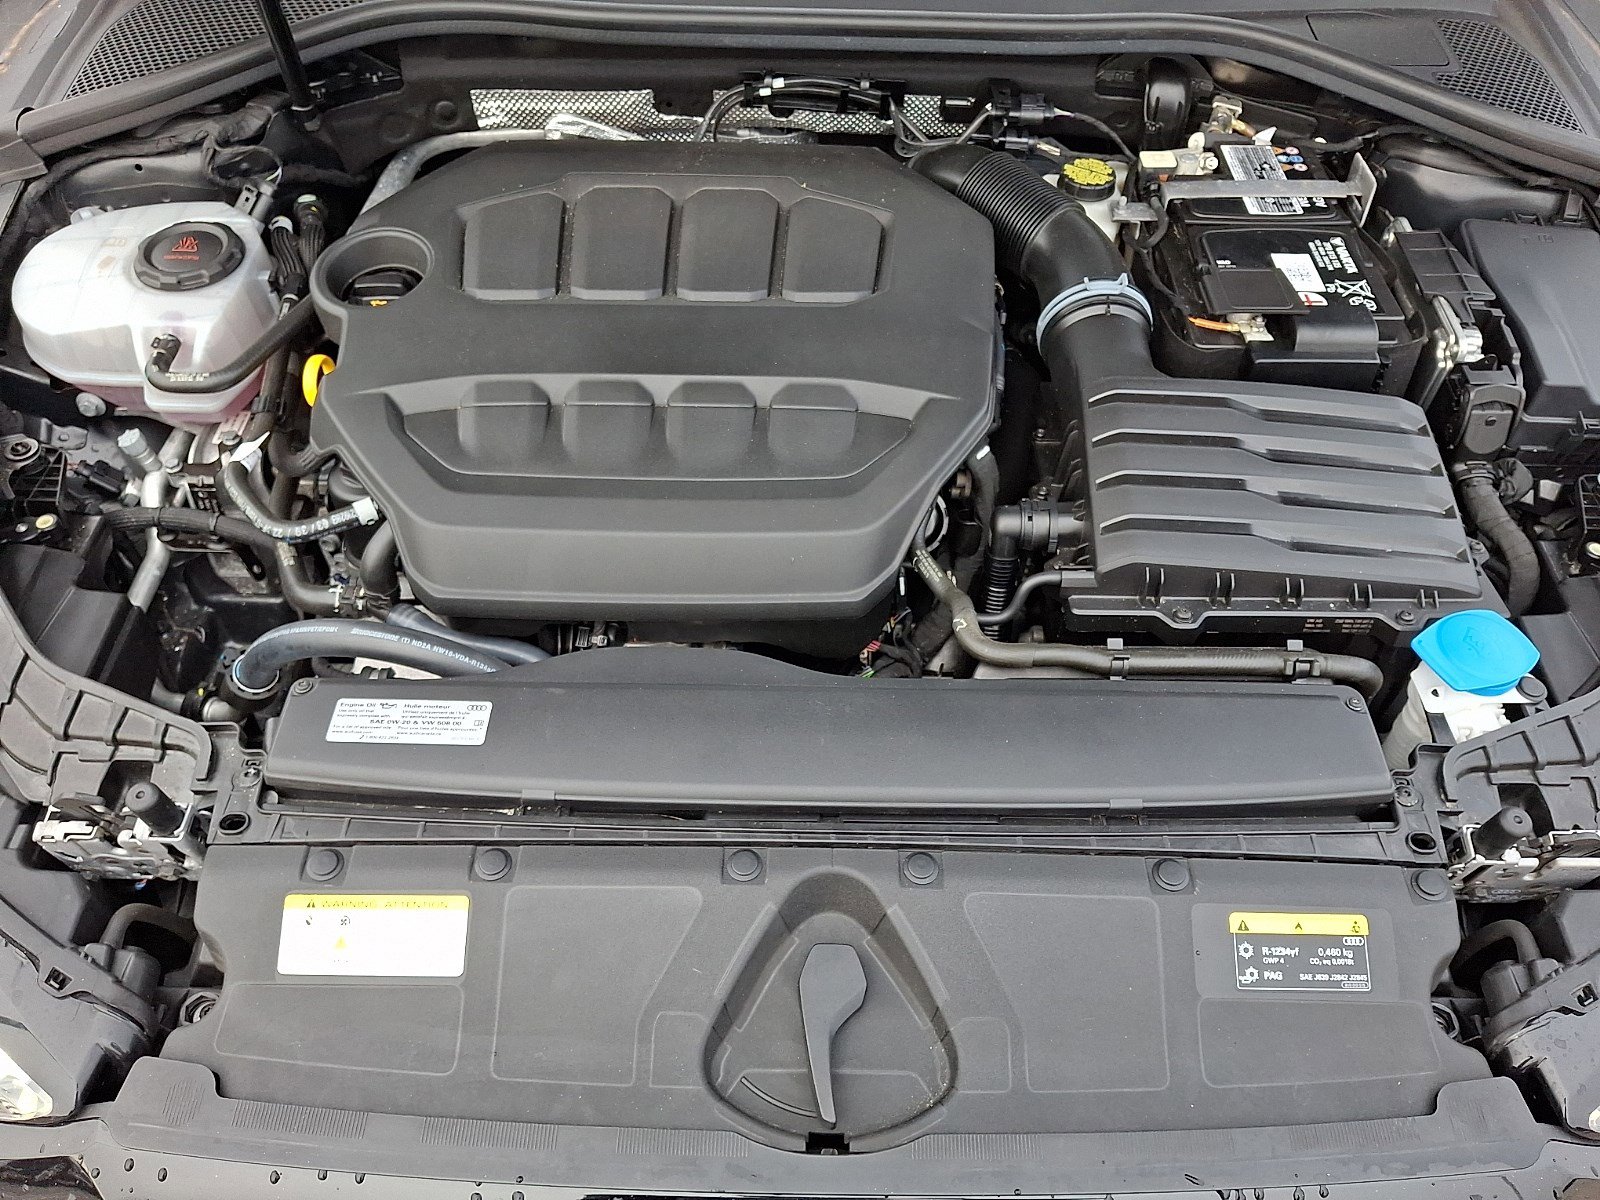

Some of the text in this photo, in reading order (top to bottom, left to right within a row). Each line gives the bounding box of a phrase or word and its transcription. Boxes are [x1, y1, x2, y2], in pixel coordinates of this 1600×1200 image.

[1335, 244, 1359, 274] VARTA
[350, 628, 400, 642] BRIDGESTONE
[322, 900, 448, 908] WARNING ATTENTION
[1262, 946, 1299, 957] R-1234yf
[1343, 948, 1354, 958] kg
[1264, 970, 1283, 981] PAG
